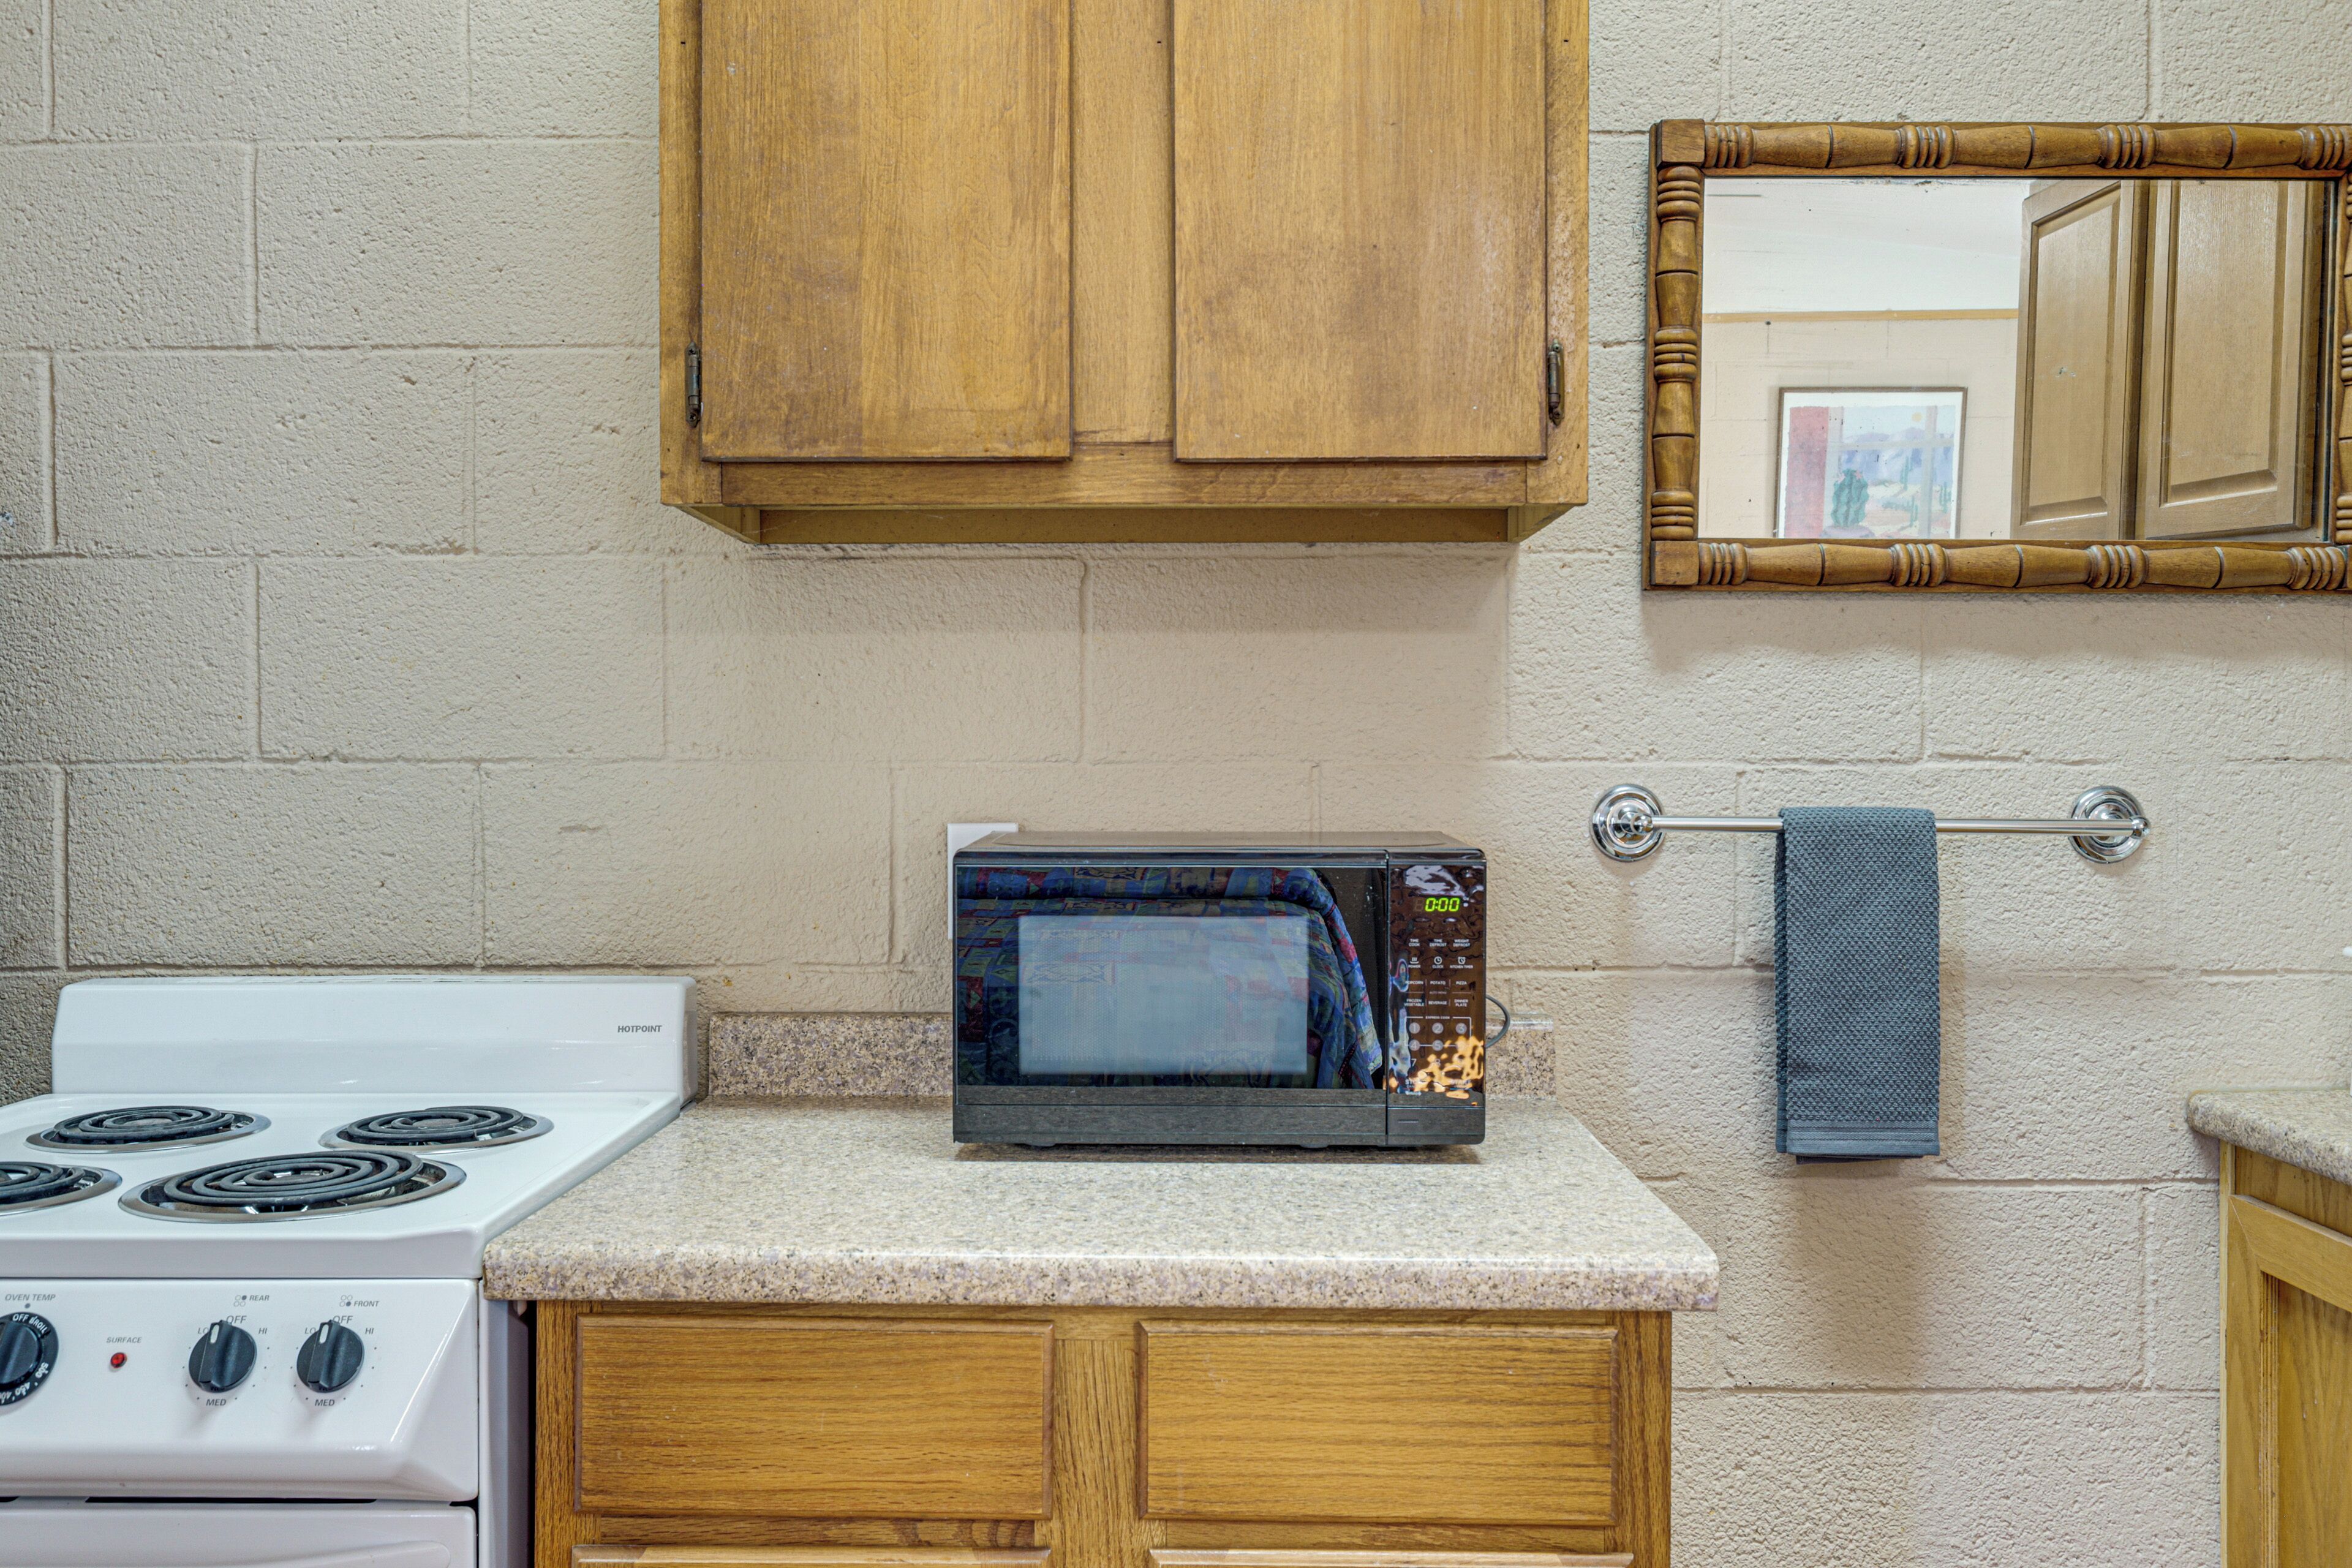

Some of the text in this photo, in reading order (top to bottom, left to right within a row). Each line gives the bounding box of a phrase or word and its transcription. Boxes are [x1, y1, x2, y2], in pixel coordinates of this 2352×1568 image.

[1425, 897, 1460, 912] 0:00
[12, 1313, 29, 1322] OFF
[226, 1315, 247, 1324] OFF
[332, 1315, 353, 1324] OFF
[29, 1316, 48, 1334] BROIL
